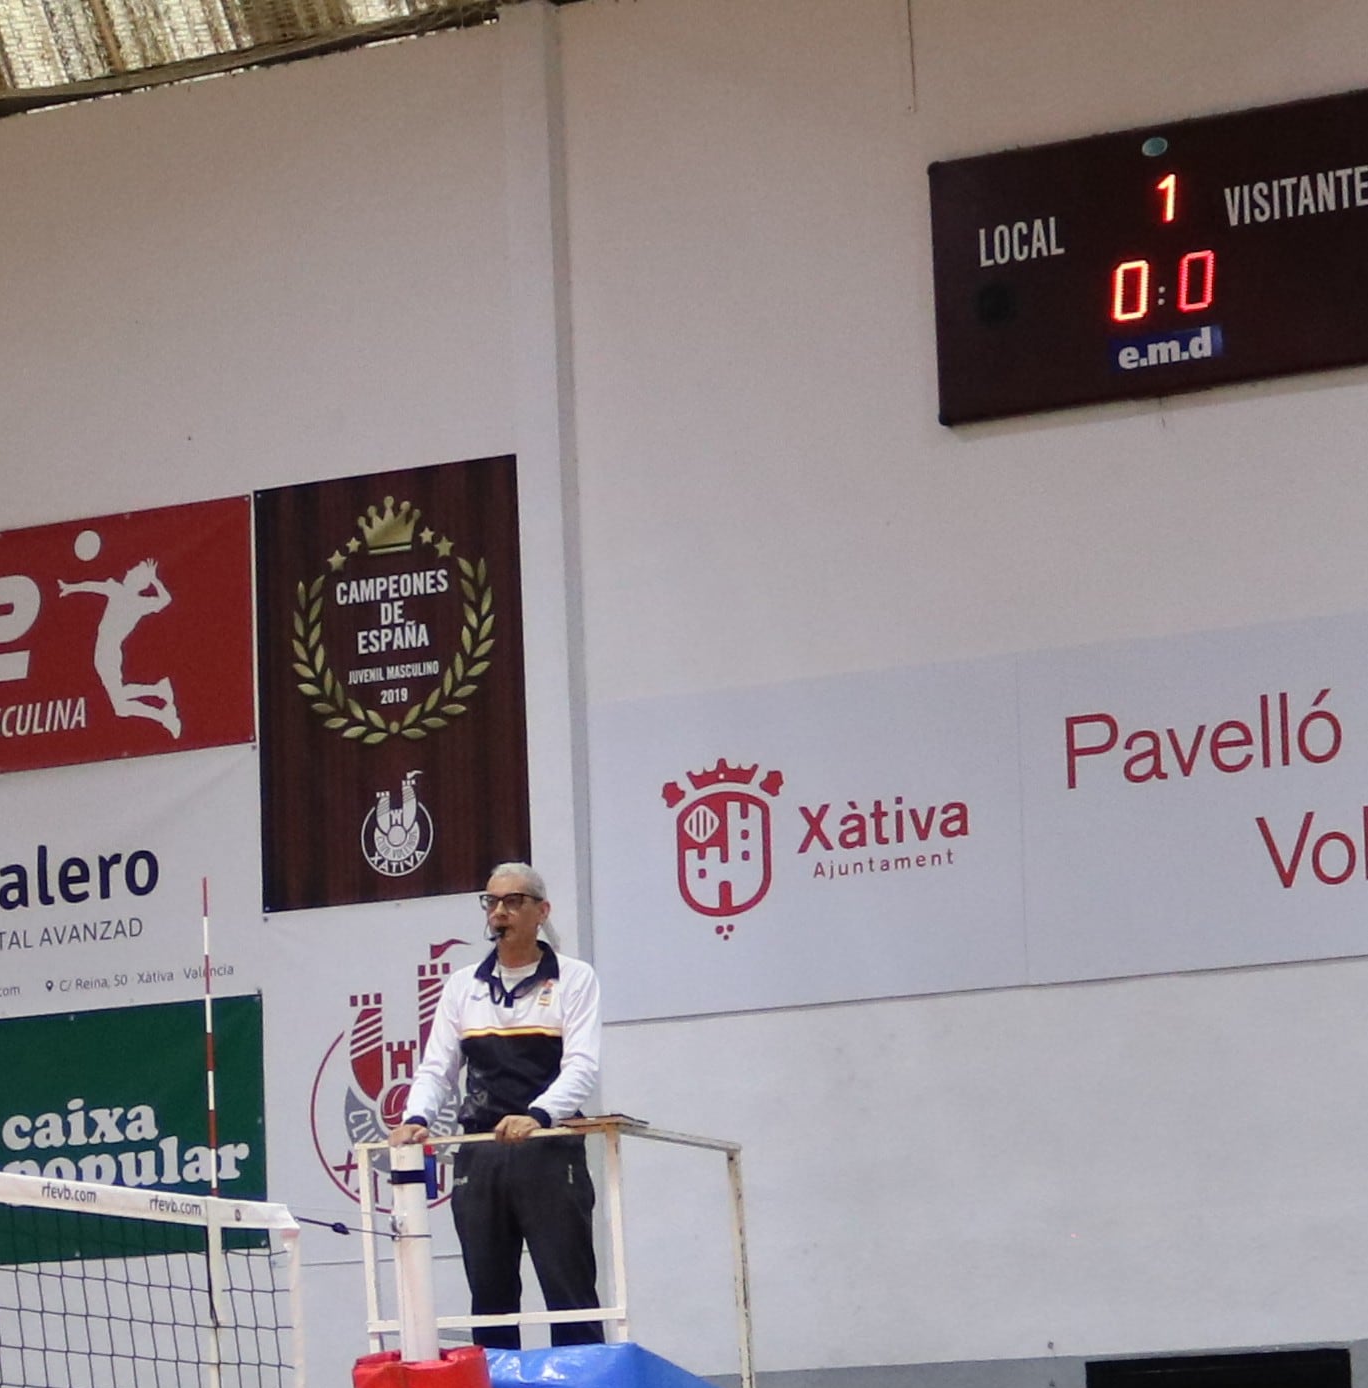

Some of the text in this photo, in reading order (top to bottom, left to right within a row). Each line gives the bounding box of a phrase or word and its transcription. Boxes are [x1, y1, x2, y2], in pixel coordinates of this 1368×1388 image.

[1155, 173, 1177, 222] 1
[1224, 165, 1368, 226] VISITANTE
[979, 217, 1065, 268] LOCAL
[1118, 326, 1212, 370] e.m.d
[335, 569, 449, 605] CAMPEONES
[380, 601, 405, 625] DE
[357, 620, 430, 655] ESPAÑA
[348, 660, 439, 685] JUVENIL MASCULINO
[380, 688, 408, 704] 2019
[1065, 688, 1342, 790] Pavelló
[797, 796, 970, 855] Xàtiva
[813, 848, 954, 879] Ajuntament
[39, 917, 143, 947] AVANZAD
[2, 1098, 158, 1150] caixa
[42, 1176, 96, 1204] rfevb.com
[149, 1196, 201, 1217] rfevb.com
